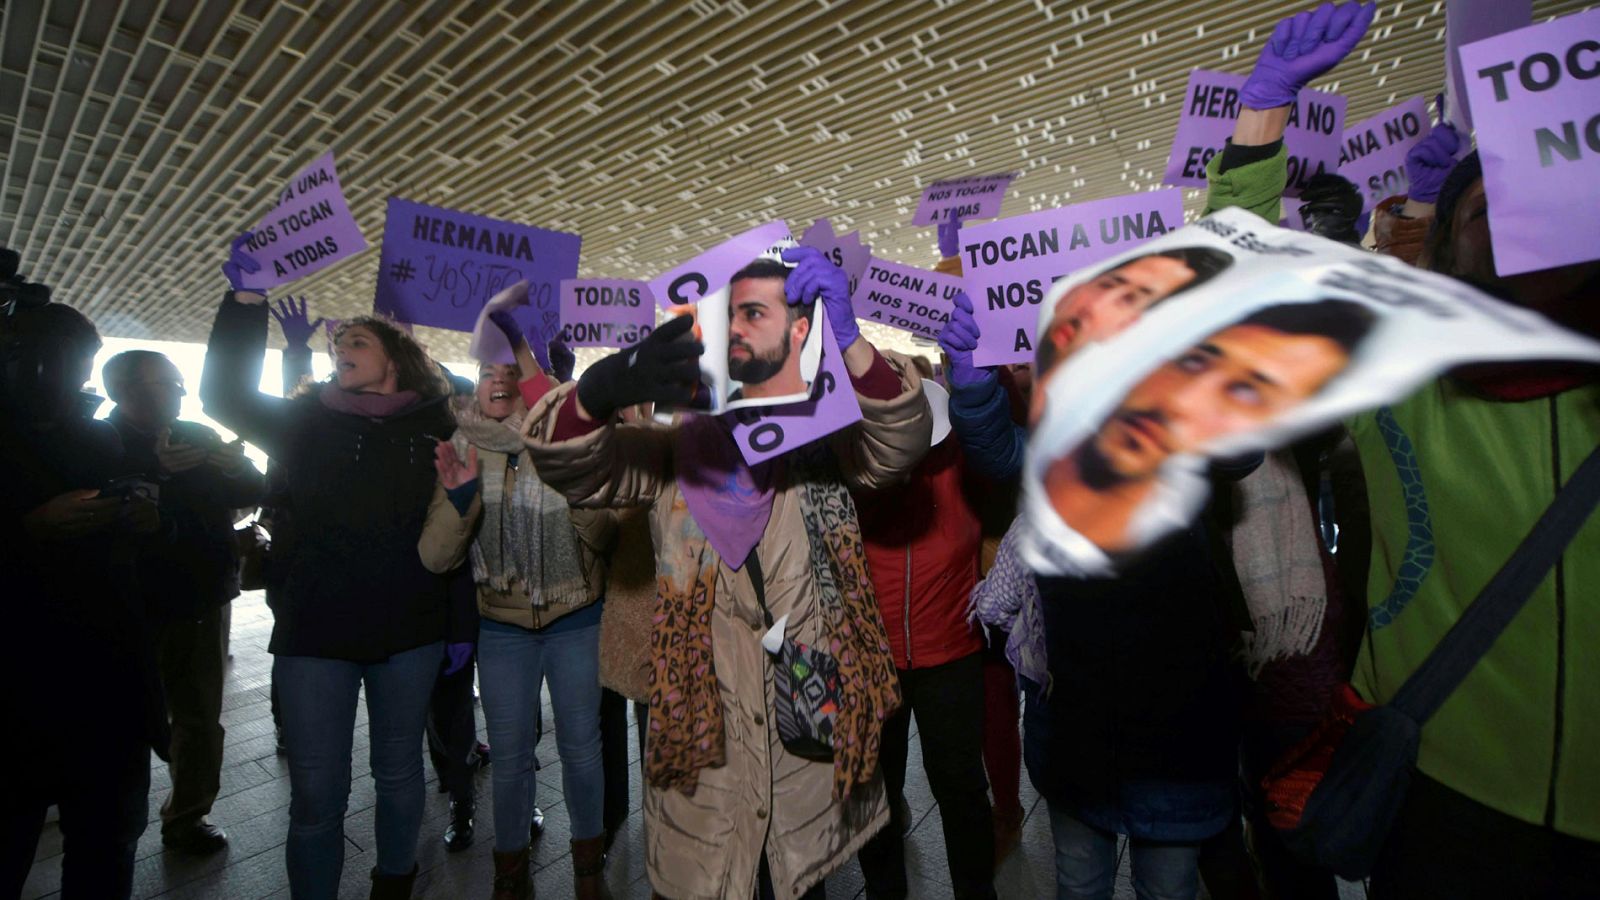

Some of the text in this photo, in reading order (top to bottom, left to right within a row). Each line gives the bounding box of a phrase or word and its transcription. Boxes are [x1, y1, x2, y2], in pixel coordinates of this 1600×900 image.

[1477, 39, 1600, 103] TOC
[1189, 84, 1336, 136] HERA NO
[1338, 111, 1420, 168] ANA NO
[928, 183, 998, 202] NOS TOCAN
[245, 199, 334, 253] NOS TOCAN
[930, 203, 981, 221] A TDAS
[413, 214, 535, 263] HERMANA
[965, 227, 1060, 268] TOCAN
[1069, 223, 1091, 251] A
[273, 235, 338, 278] A TODAS
[574, 286, 641, 308] TODAS
[869, 266, 924, 293] TOCAN
[925, 282, 938, 297] A
[986, 279, 1044, 311] NOS
[867, 290, 951, 324] NOS TOCA
[563, 322, 653, 344] CONTIGO
[870, 310, 942, 338] A TODAS
[1014, 328, 1033, 352] A
